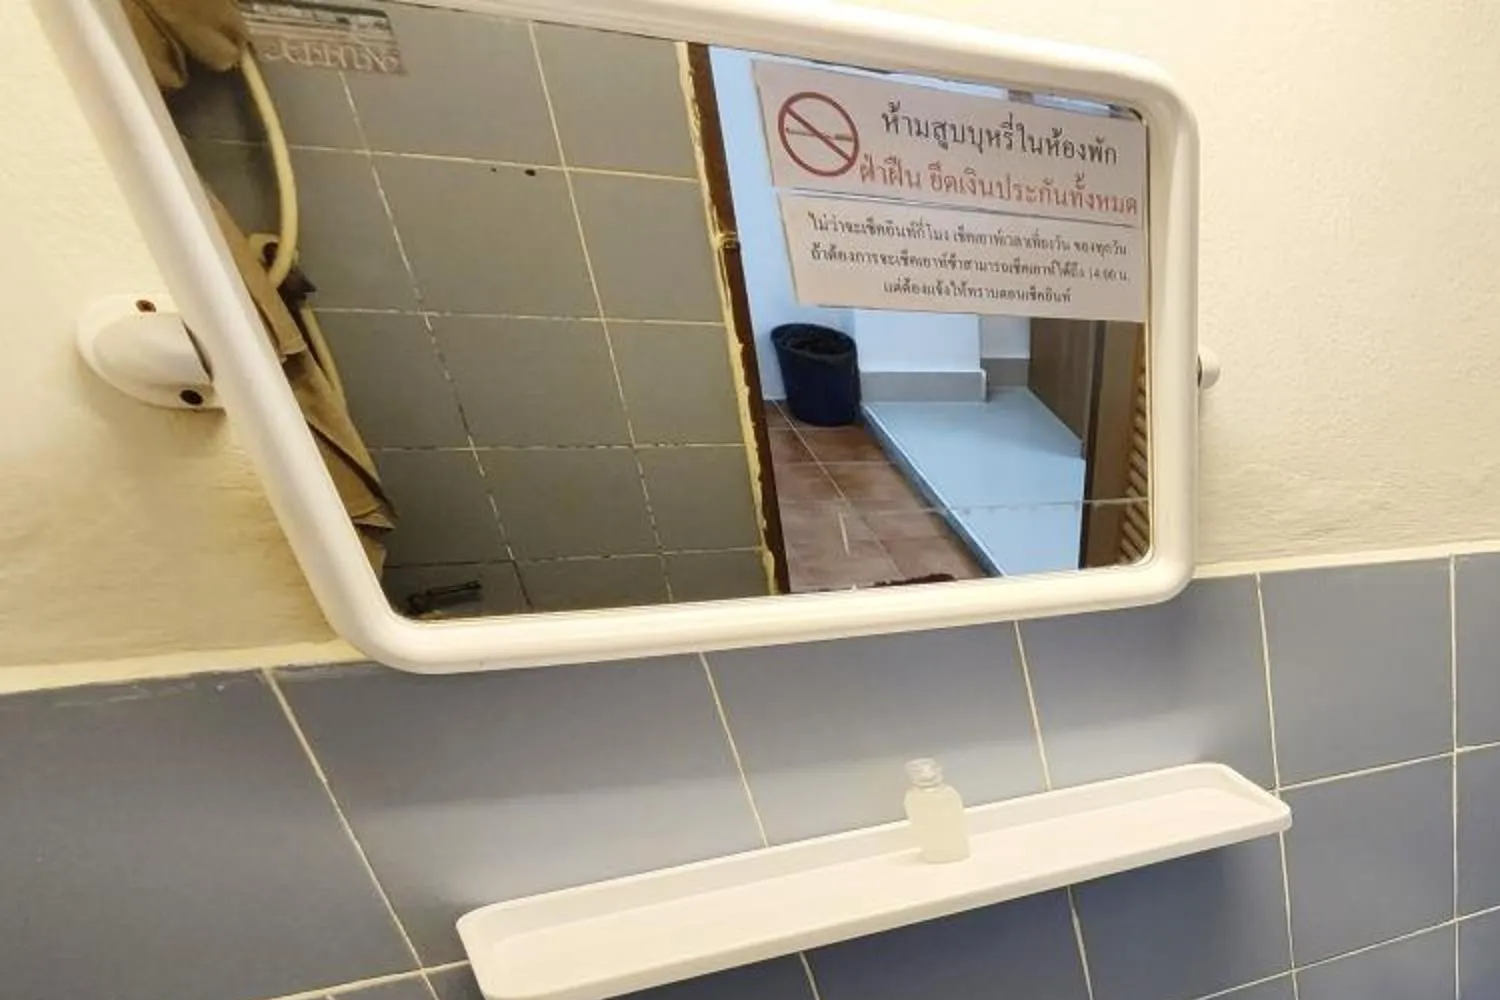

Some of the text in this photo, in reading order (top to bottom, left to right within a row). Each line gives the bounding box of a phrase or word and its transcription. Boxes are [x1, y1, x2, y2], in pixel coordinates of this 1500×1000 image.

[881, 100, 1118, 165] ห้ามสูบบุหรี่ในห้องพัก
[859, 152, 1138, 216] ฝ่าฝืน ยึดเงินประกันทั้งหมด
